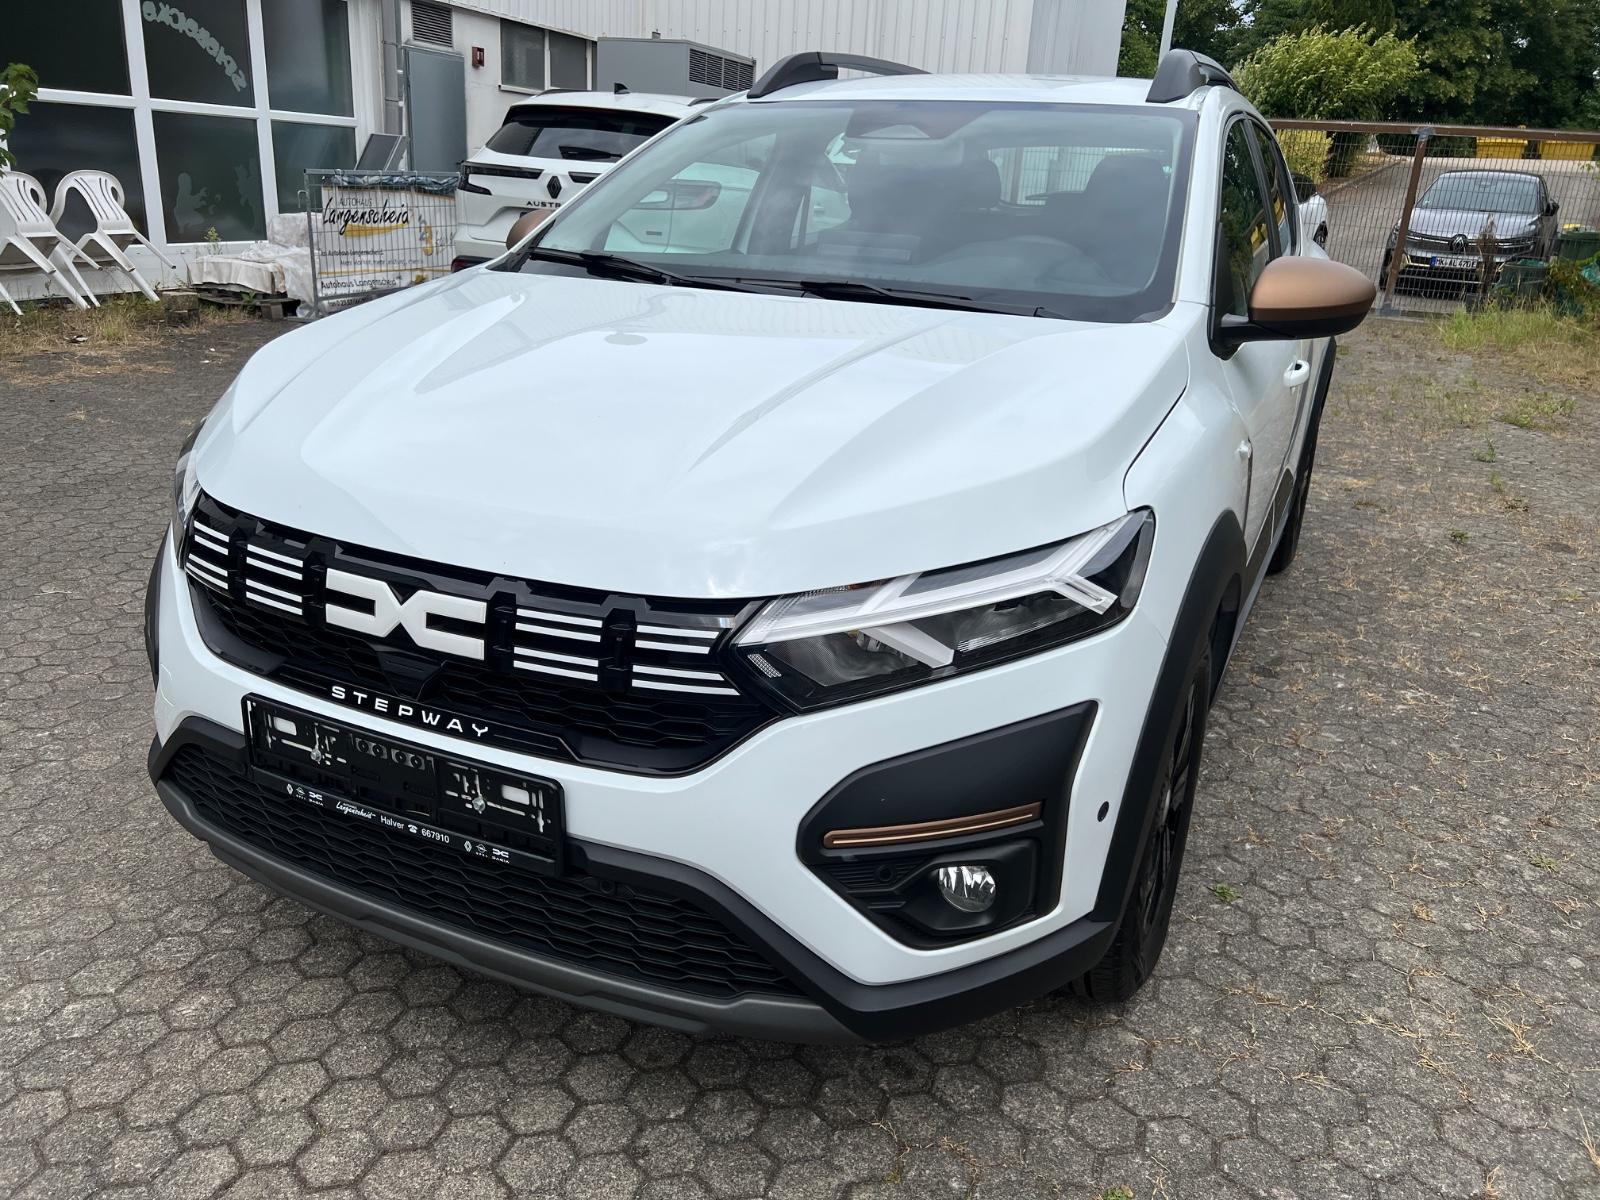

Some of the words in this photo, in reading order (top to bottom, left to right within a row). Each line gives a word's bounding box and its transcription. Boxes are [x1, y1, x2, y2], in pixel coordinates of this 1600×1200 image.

[331, 685, 489, 738] STEPWAY
[380, 815, 404, 830] Halver
[421, 828, 450, 843] 667910
